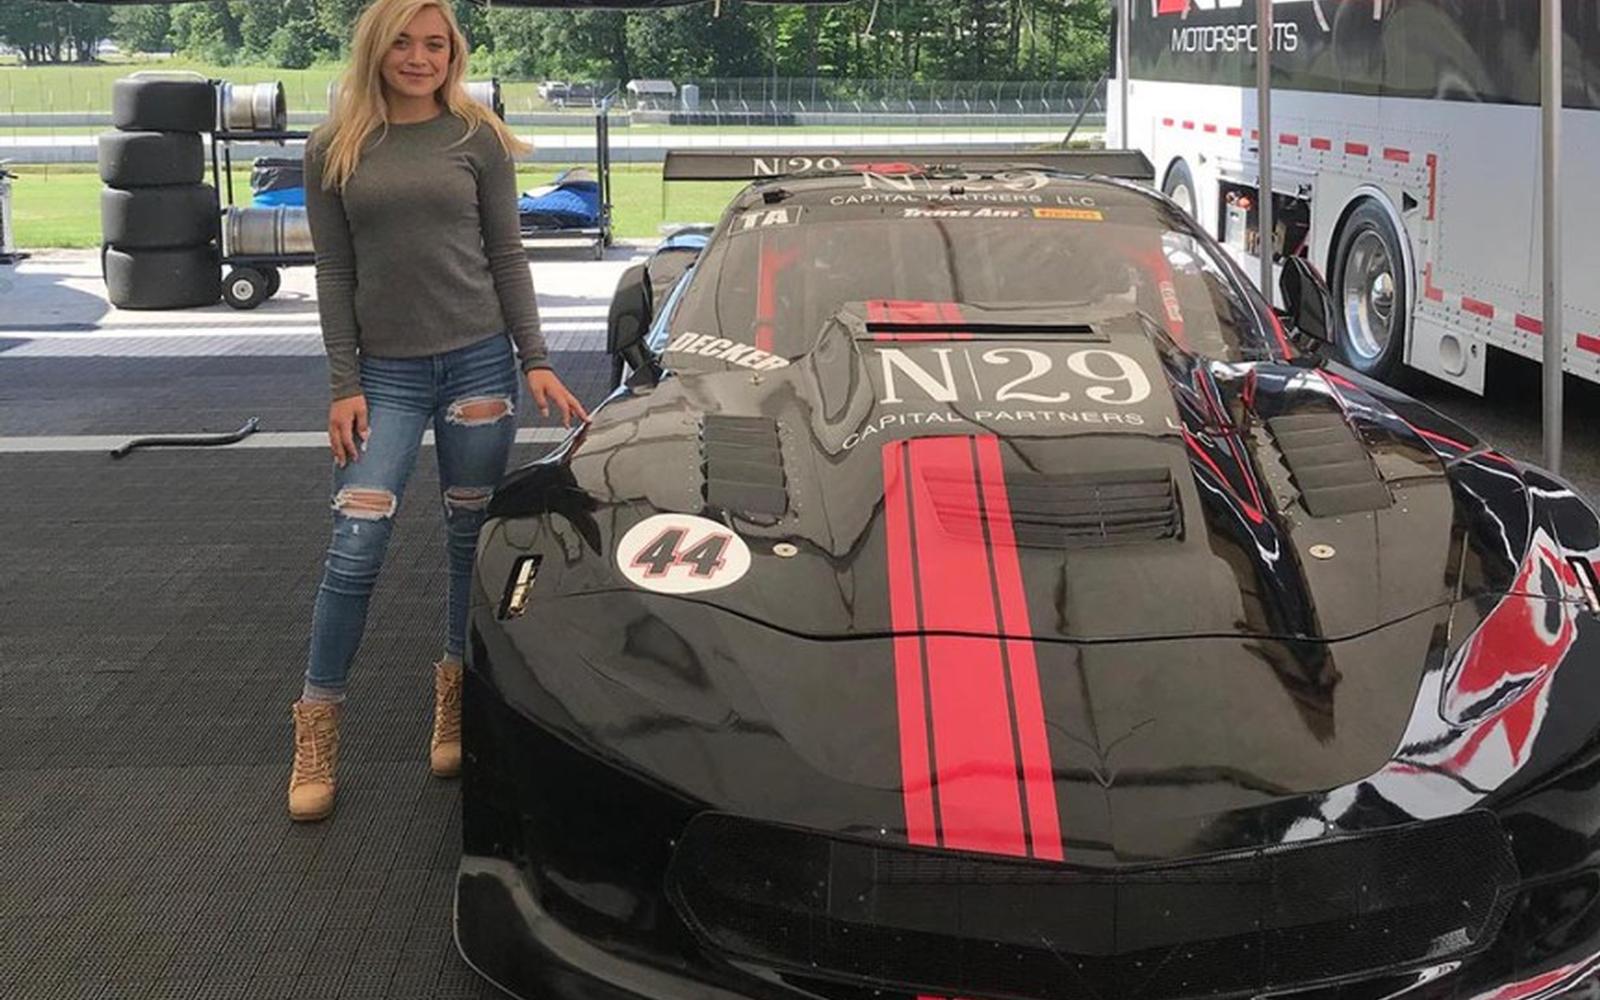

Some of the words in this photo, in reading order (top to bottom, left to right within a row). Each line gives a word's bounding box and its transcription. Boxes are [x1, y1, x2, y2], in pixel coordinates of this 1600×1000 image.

[1171, 23, 1298, 51] MOTORSPOTS
[829, 193, 919, 206] CAPITAL
[927, 193, 1042, 204] PARTNERS
[1056, 195, 1096, 207] LLC
[740, 209, 789, 230] TA
[667, 332, 791, 372] DECKER
[842, 412, 964, 450] CAPITAL
[974, 410, 1145, 426] PARTNERS
[630, 526, 733, 580] 44
